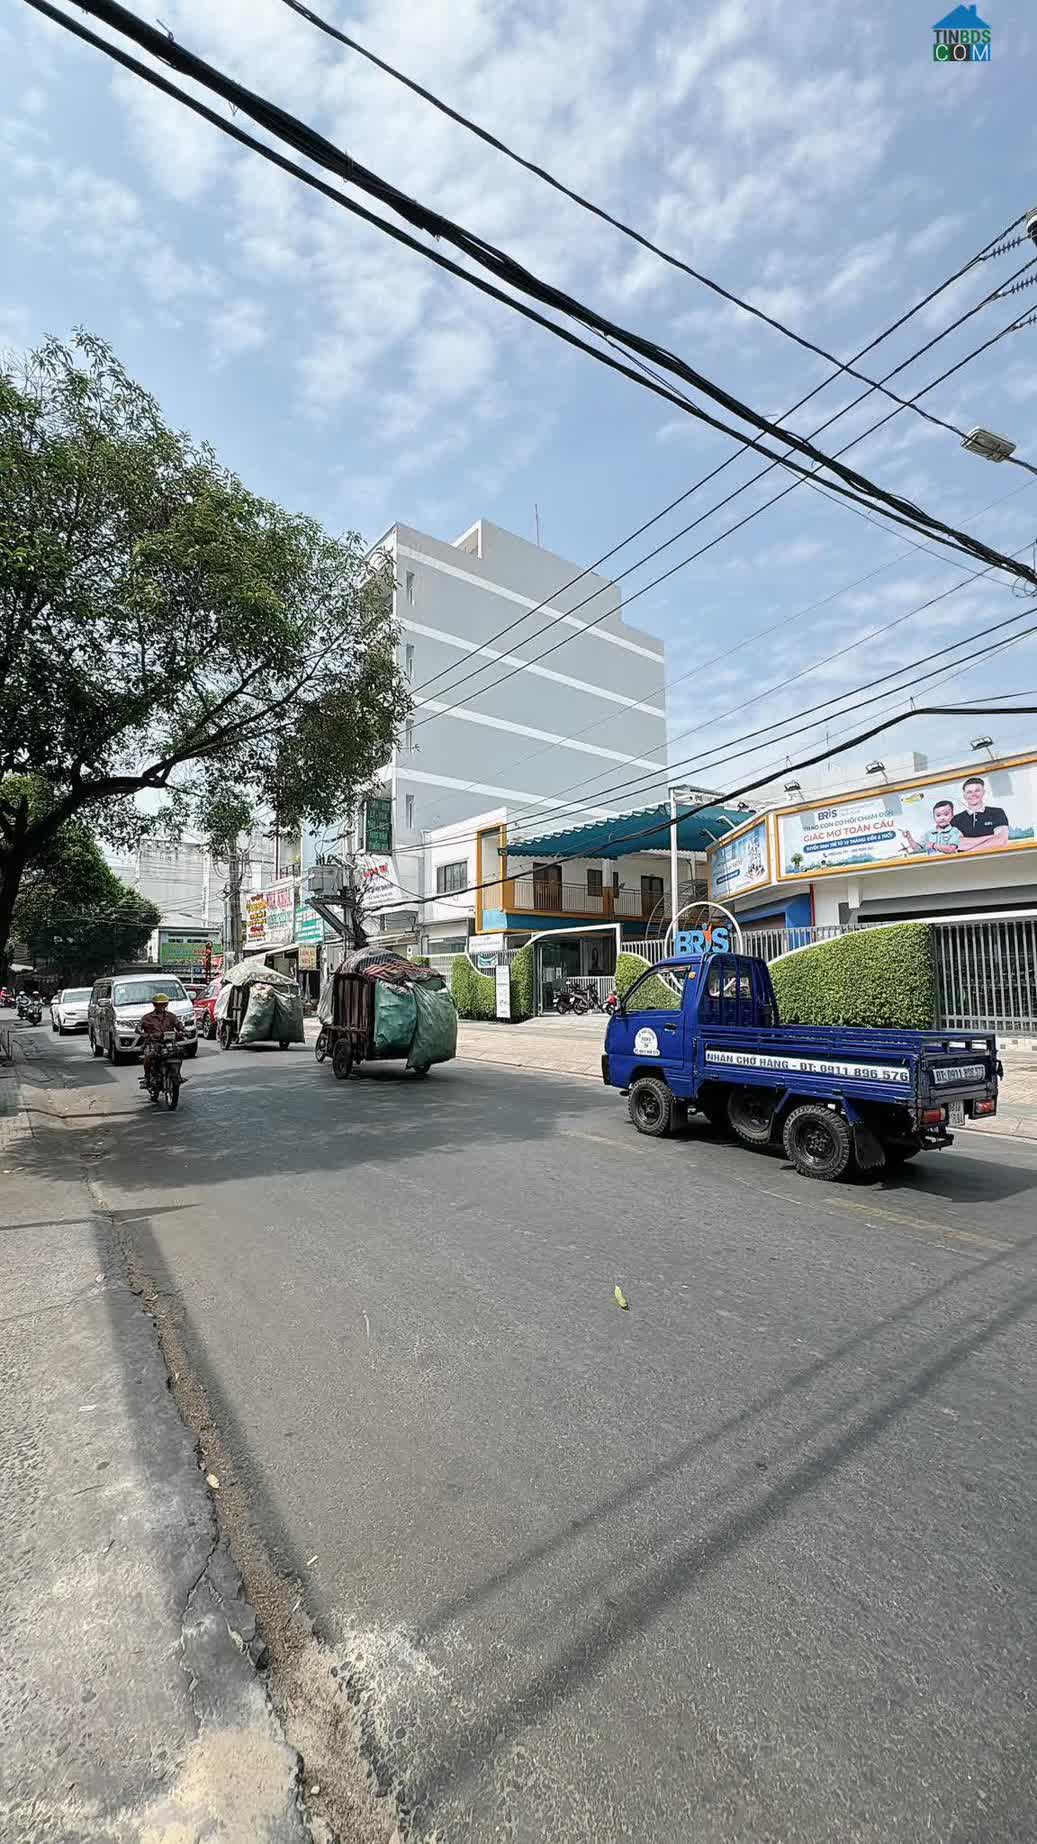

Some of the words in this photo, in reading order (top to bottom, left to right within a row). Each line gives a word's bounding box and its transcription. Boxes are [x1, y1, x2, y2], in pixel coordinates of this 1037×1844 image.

[820, 821, 834, 829] CON
[826, 828, 842, 838] MƠ
[819, 1064, 849, 1076] 0911
[854, 1068, 878, 1080] 896
[882, 1071, 909, 1083] 576
